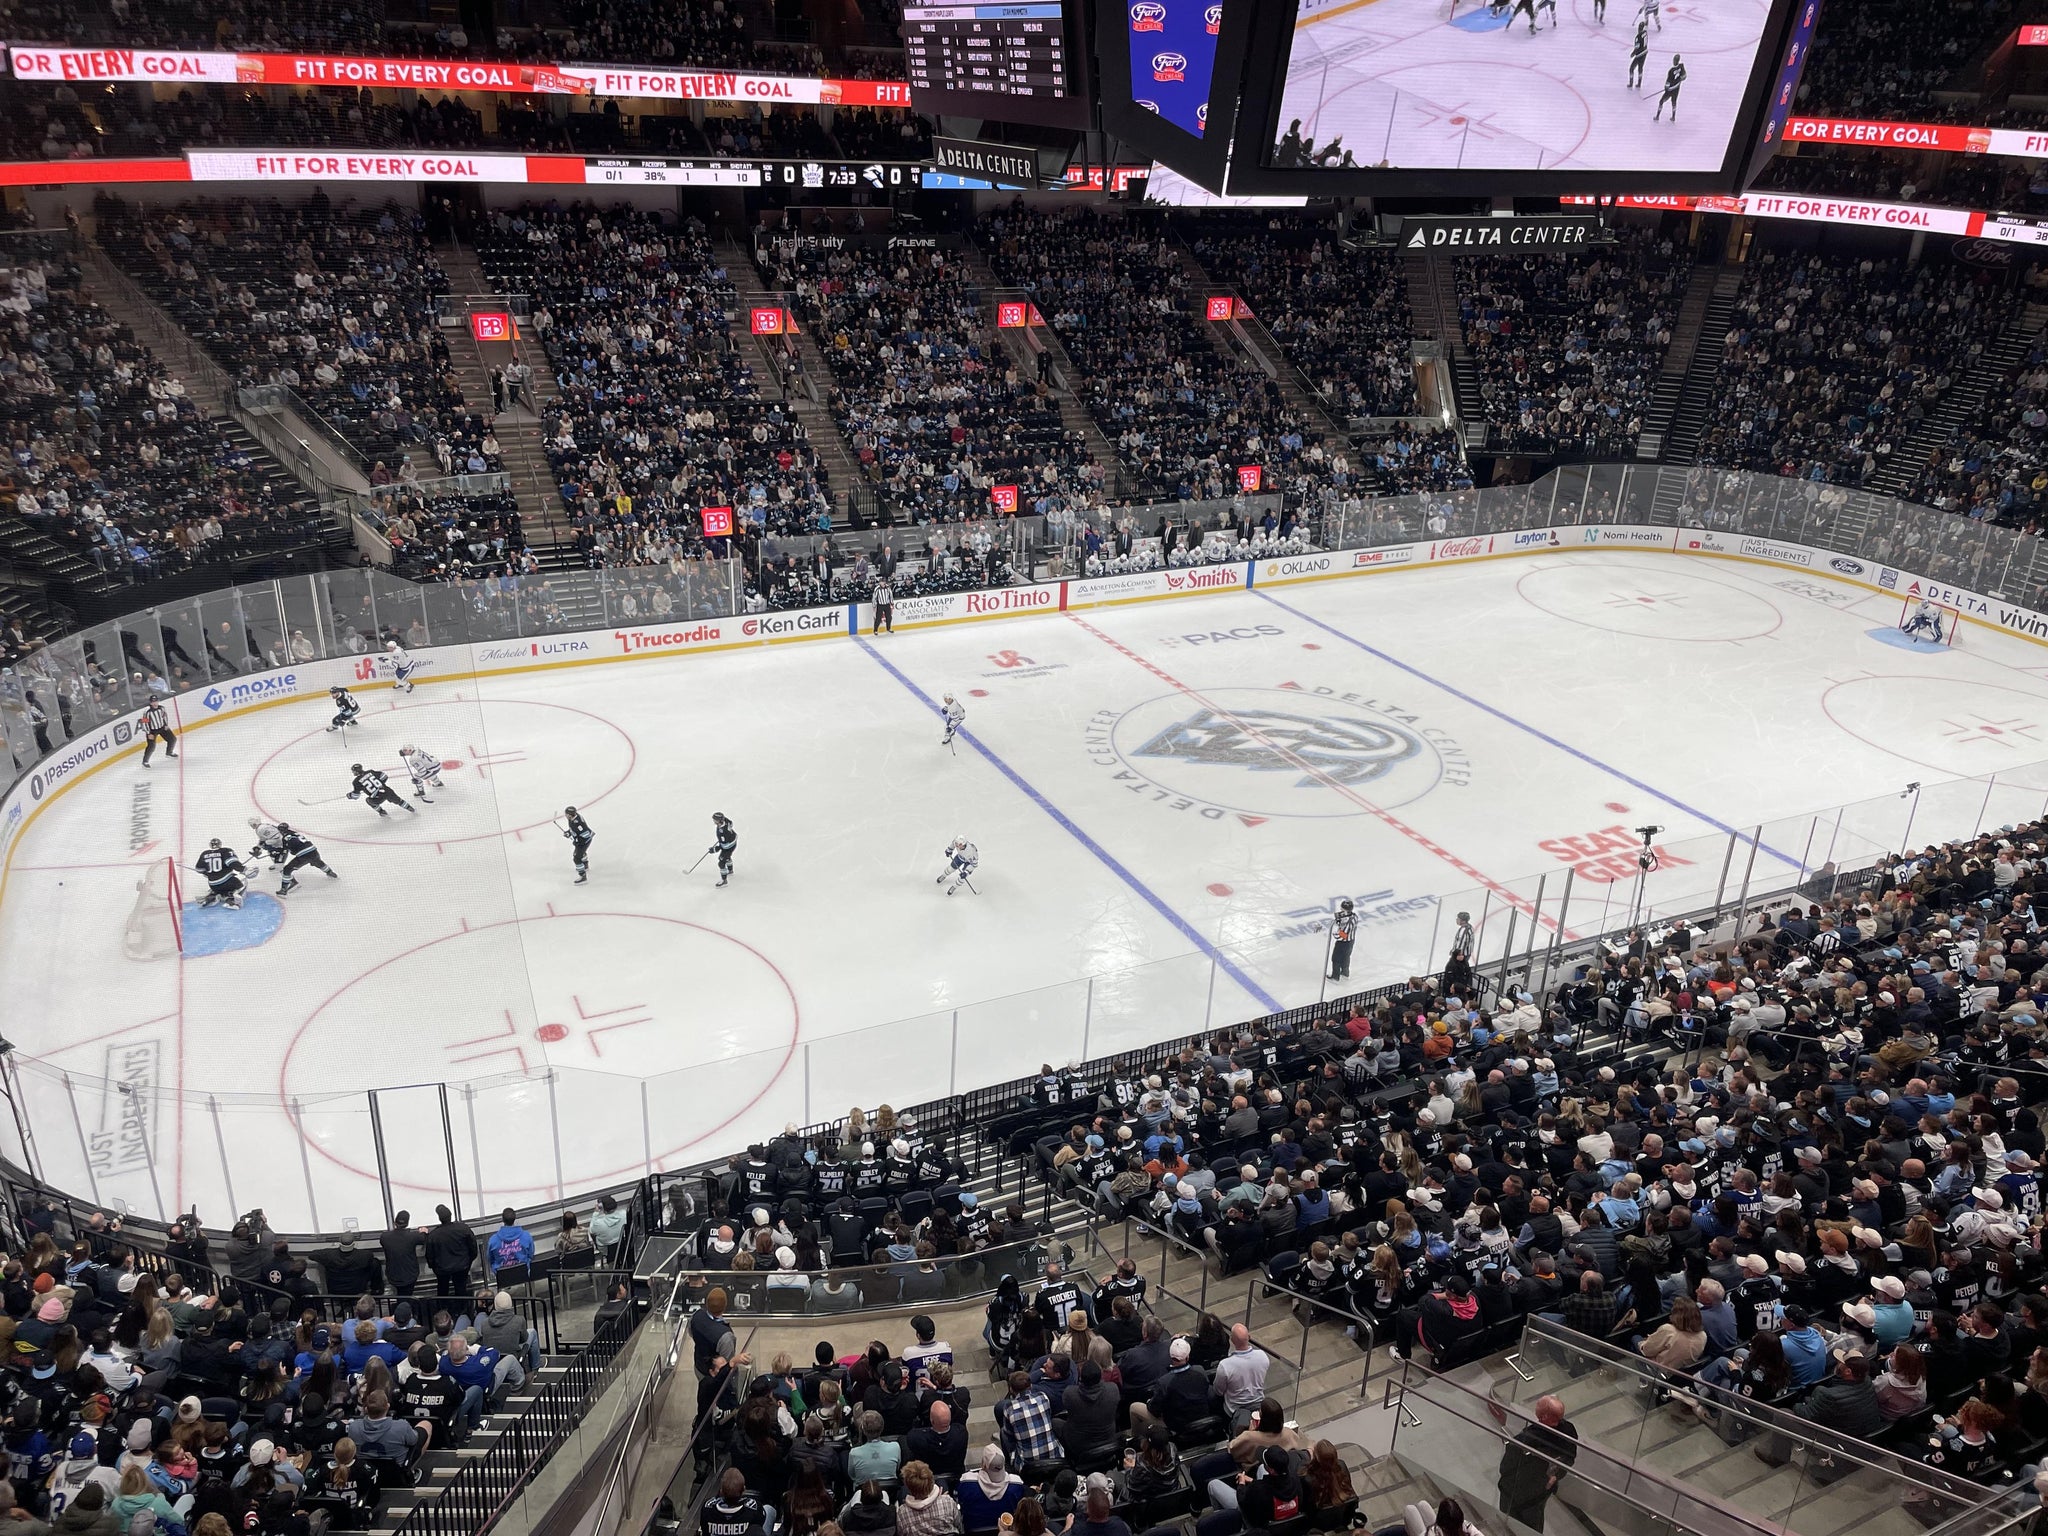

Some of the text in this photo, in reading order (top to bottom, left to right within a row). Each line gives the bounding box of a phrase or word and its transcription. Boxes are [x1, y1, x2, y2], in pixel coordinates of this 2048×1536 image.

[60, 50, 135, 80] EVERY
[143, 57, 206, 75] GOAL
[1158, 56, 1182, 72] Farr
[296, 61, 513, 86] FIT FOR EVERY GOAL
[606, 73, 792, 98] FIT FOR EVERY GOAL
[876, 86, 900, 101] FIT
[1792, 122, 1827, 138] FOR
[1832, 125, 1890, 142] EVERY
[1893, 128, 1939, 145] GOAL
[256, 158, 478, 176] FIT FOR EVERY GOAL
[947, 149, 1032, 179] DELTA CENTER
[606, 171, 622, 180] 0/1
[644, 172, 666, 181] 38%
[686, 172, 690, 182] 1
[714, 173, 718, 182] 1
[737, 173, 748, 182] 10
[764, 172, 772, 182] 6
[784, 166, 795, 183] 0
[830, 172, 856, 184] 7:33
[890, 168, 902, 184] 0
[911, 175, 919, 184] 4
[936, 178, 942, 186] 7
[959, 177, 965, 186] 6
[1757, 199, 1930, 226] FIT FOR EVERY GOAL
[1432, 226, 1586, 246] DELTA CENTER
[2000, 228, 2016, 237] 0/1
[480, 318, 502, 336] PB
[758, 314, 777, 330] PB
[706, 513, 728, 531] PB
[1514, 531, 1547, 546] Layton
[1603, 531, 1662, 542] Nomi Health
[1746, 538, 1766, 547] JUST
[1701, 542, 1724, 552] YouTube
[1744, 545, 1807, 563] INGREDIENTS
[1358, 550, 1410, 564] SME STEEL
[1282, 558, 1330, 576] OKLAND
[1835, 560, 1859, 573] Ford
[1089, 584, 1120, 592] MORETON
[1126, 579, 1156, 588] COMPANY
[1186, 567, 1238, 589] Smith's
[895, 597, 954, 610] CRAIG SWAPP
[966, 590, 1051, 613] Rio Tinto
[1928, 586, 1988, 615] DELTA
[908, 604, 949, 614] ASSOCIATES
[760, 612, 840, 634] Ken Garff
[630, 625, 721, 648] Trucordia
[1182, 624, 1286, 646] PACS
[479, 642, 589, 662] Michelob ULTRA
[232, 674, 297, 699] moxie
[232, 686, 298, 705] PEST CONTROL
[1086, 708, 1122, 766] CENTER
[1314, 686, 1471, 788] DELTA CENTER
[44, 734, 110, 786] 1Password
[1112, 769, 1226, 821] DELTA
[130, 782, 152, 850] CROWDSTRIKE
[1538, 824, 1646, 862] SEAT
[1376, 894, 1440, 916] FIRST
[1115, 1083, 1134, 1101] 98
[119, 1047, 151, 1166] INGREDIENTS
[1432, 1133, 1442, 1142] LEE
[90, 1131, 114, 1170] JUST
[746, 1172, 766, 1181] KELLER
[860, 1168, 879, 1177] COOLEY
[890, 1170, 908, 1178] COOLEY
[968, 1218, 986, 1232] COOLEY
[1048, 1290, 1077, 1306] TROCHECK
[422, 1395, 444, 1406] SOBER
[707, 1522, 750, 1536] TROCHECK
